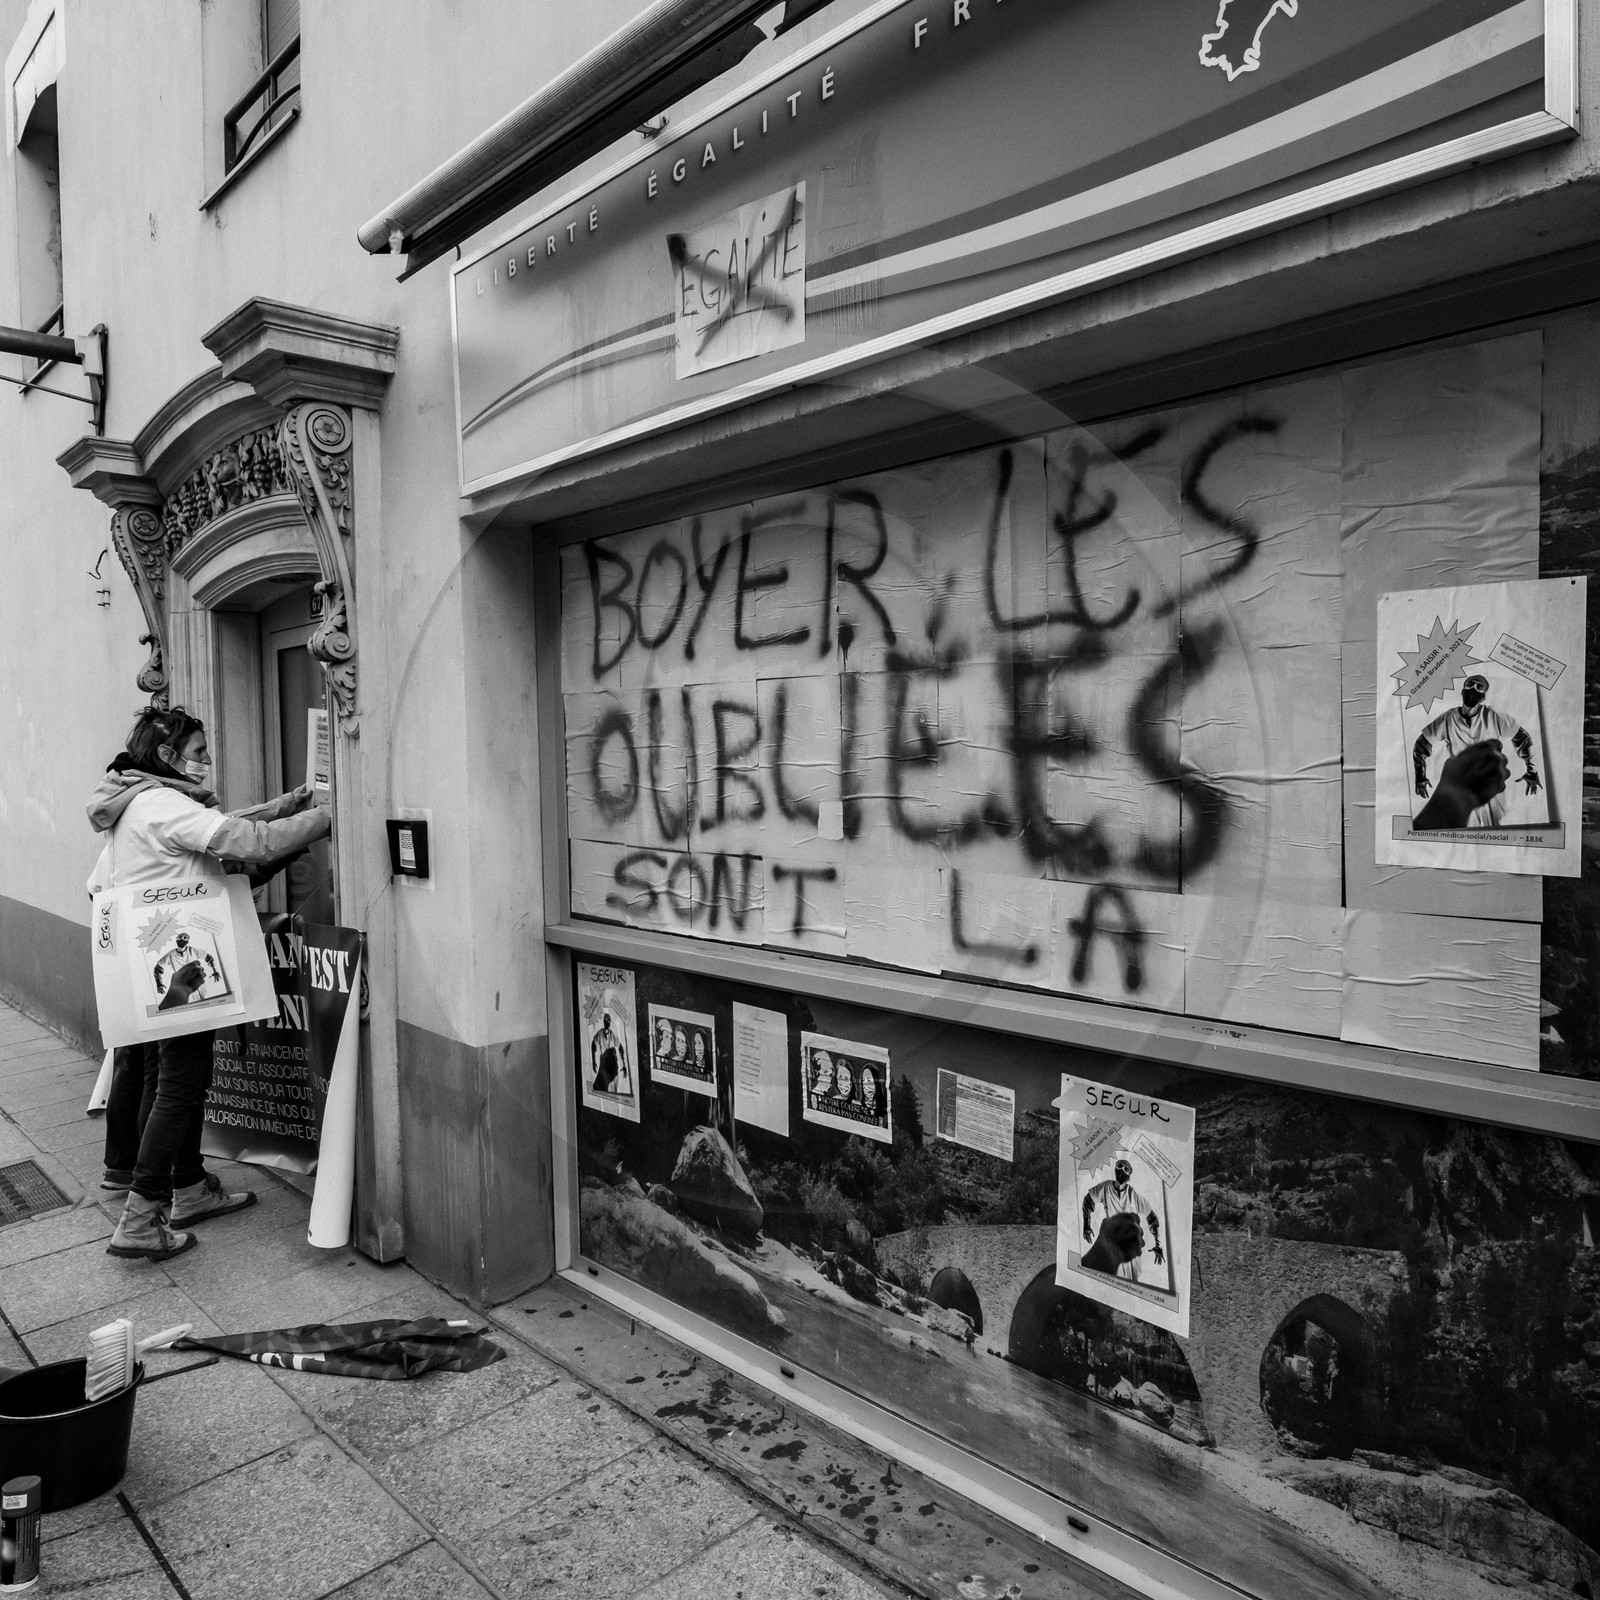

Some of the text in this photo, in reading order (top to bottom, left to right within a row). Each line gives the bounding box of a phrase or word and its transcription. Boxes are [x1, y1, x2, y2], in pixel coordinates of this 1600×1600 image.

[476, 0, 1001, 295] LIBERTÉ ÉGALITÉ FR
[986, 416, 1287, 632] LES
[1410, 638, 1464, 695] Grande Braderie 2021
[1419, 649, 1440, 671] SAISIR
[1407, 829, 1439, 838] Personnel
[1525, 835, 1544, 843] 183€
[142, 883, 208, 903] SEGUR
[605, 850, 839, 941] SONT
[98, 902, 114, 949] SEGUR
[590, 967, 627, 985] SEGUR
[213, 1057, 309, 1080] -SOCIAL ET ASSOCIATIF
[217, 1075, 233, 1089] AUX
[233, 1078, 258, 1094] SOINS
[259, 1081, 285, 1098] POUR
[264, 1100, 277, 1116] DE
[276, 1103, 299, 1119] NOS
[1086, 1086, 1170, 1122] SEGUR
